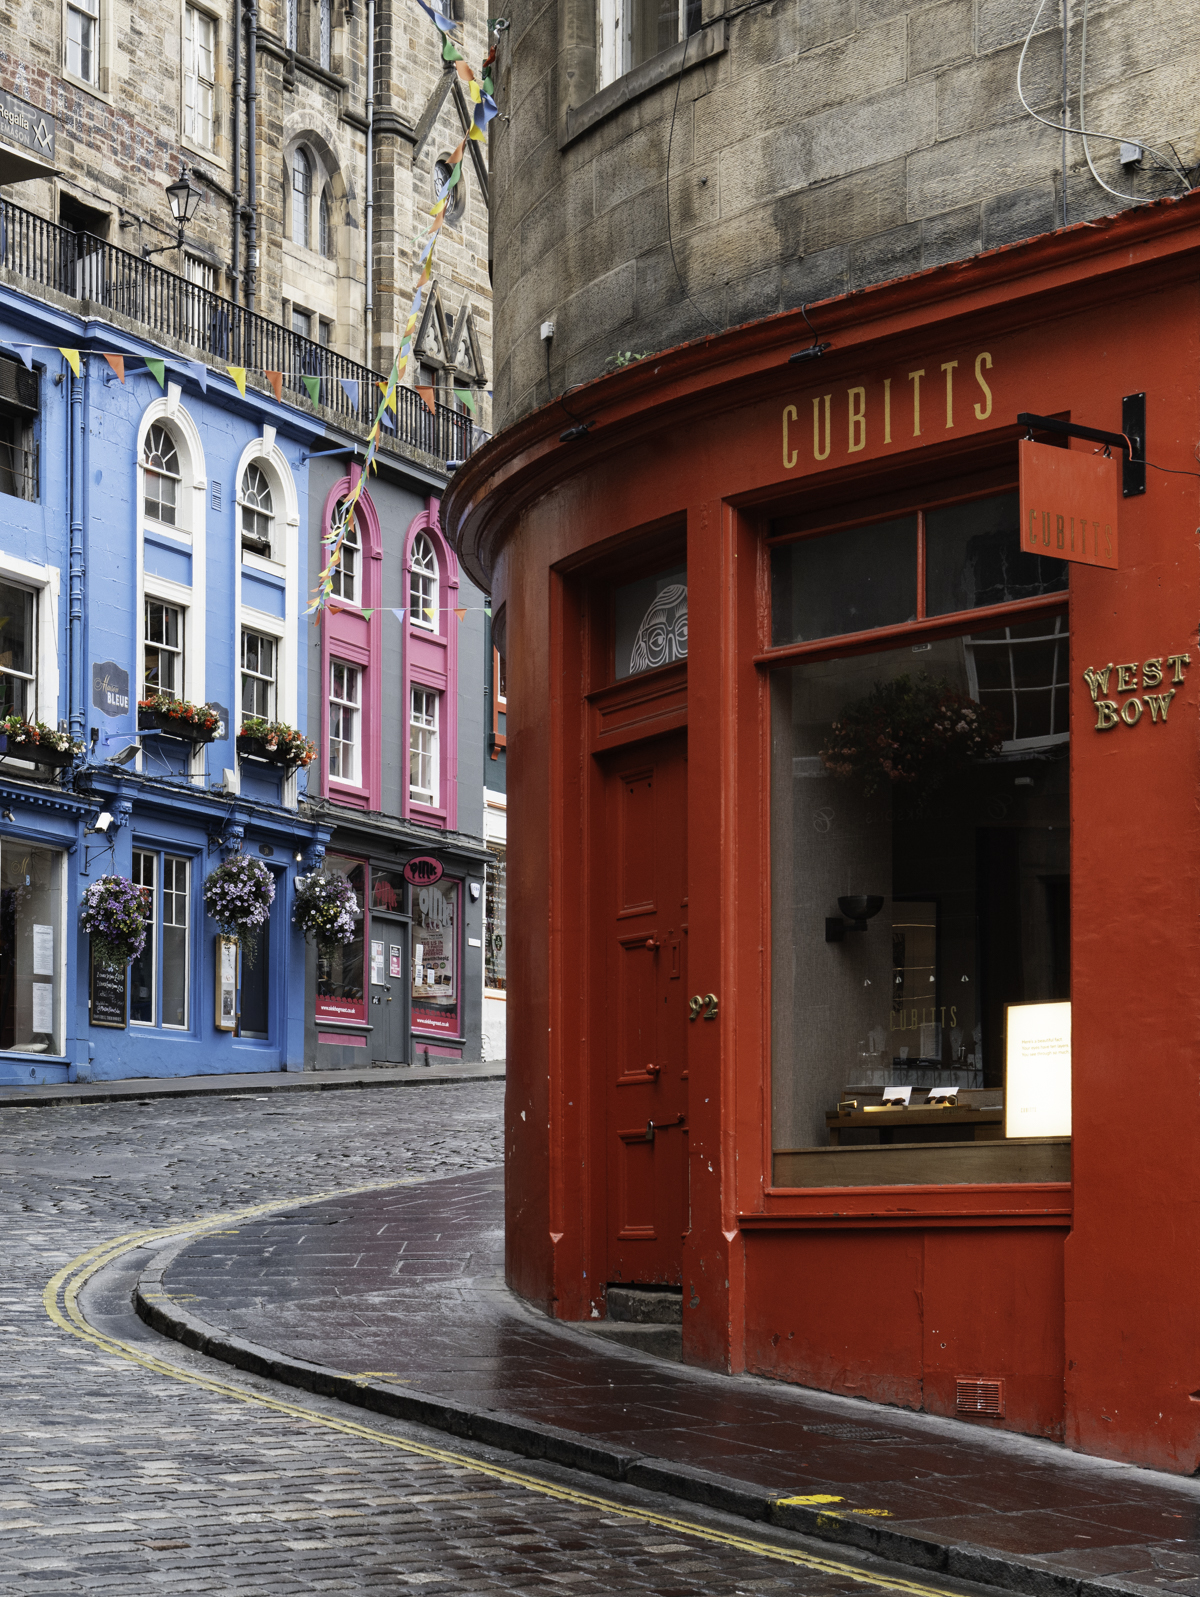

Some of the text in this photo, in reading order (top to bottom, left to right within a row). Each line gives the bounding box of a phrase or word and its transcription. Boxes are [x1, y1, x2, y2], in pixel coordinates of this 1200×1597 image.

[782, 352, 994, 468] CUBITTS
[1028, 508, 1114, 559] CUBITTS
[1083, 654, 1190, 701] WEST
[107, 692, 128, 708] BLEUE
[1094, 688, 1176, 730] BOW
[689, 994, 718, 1021] 92
[889, 1006, 957, 1031] CUBITTS
